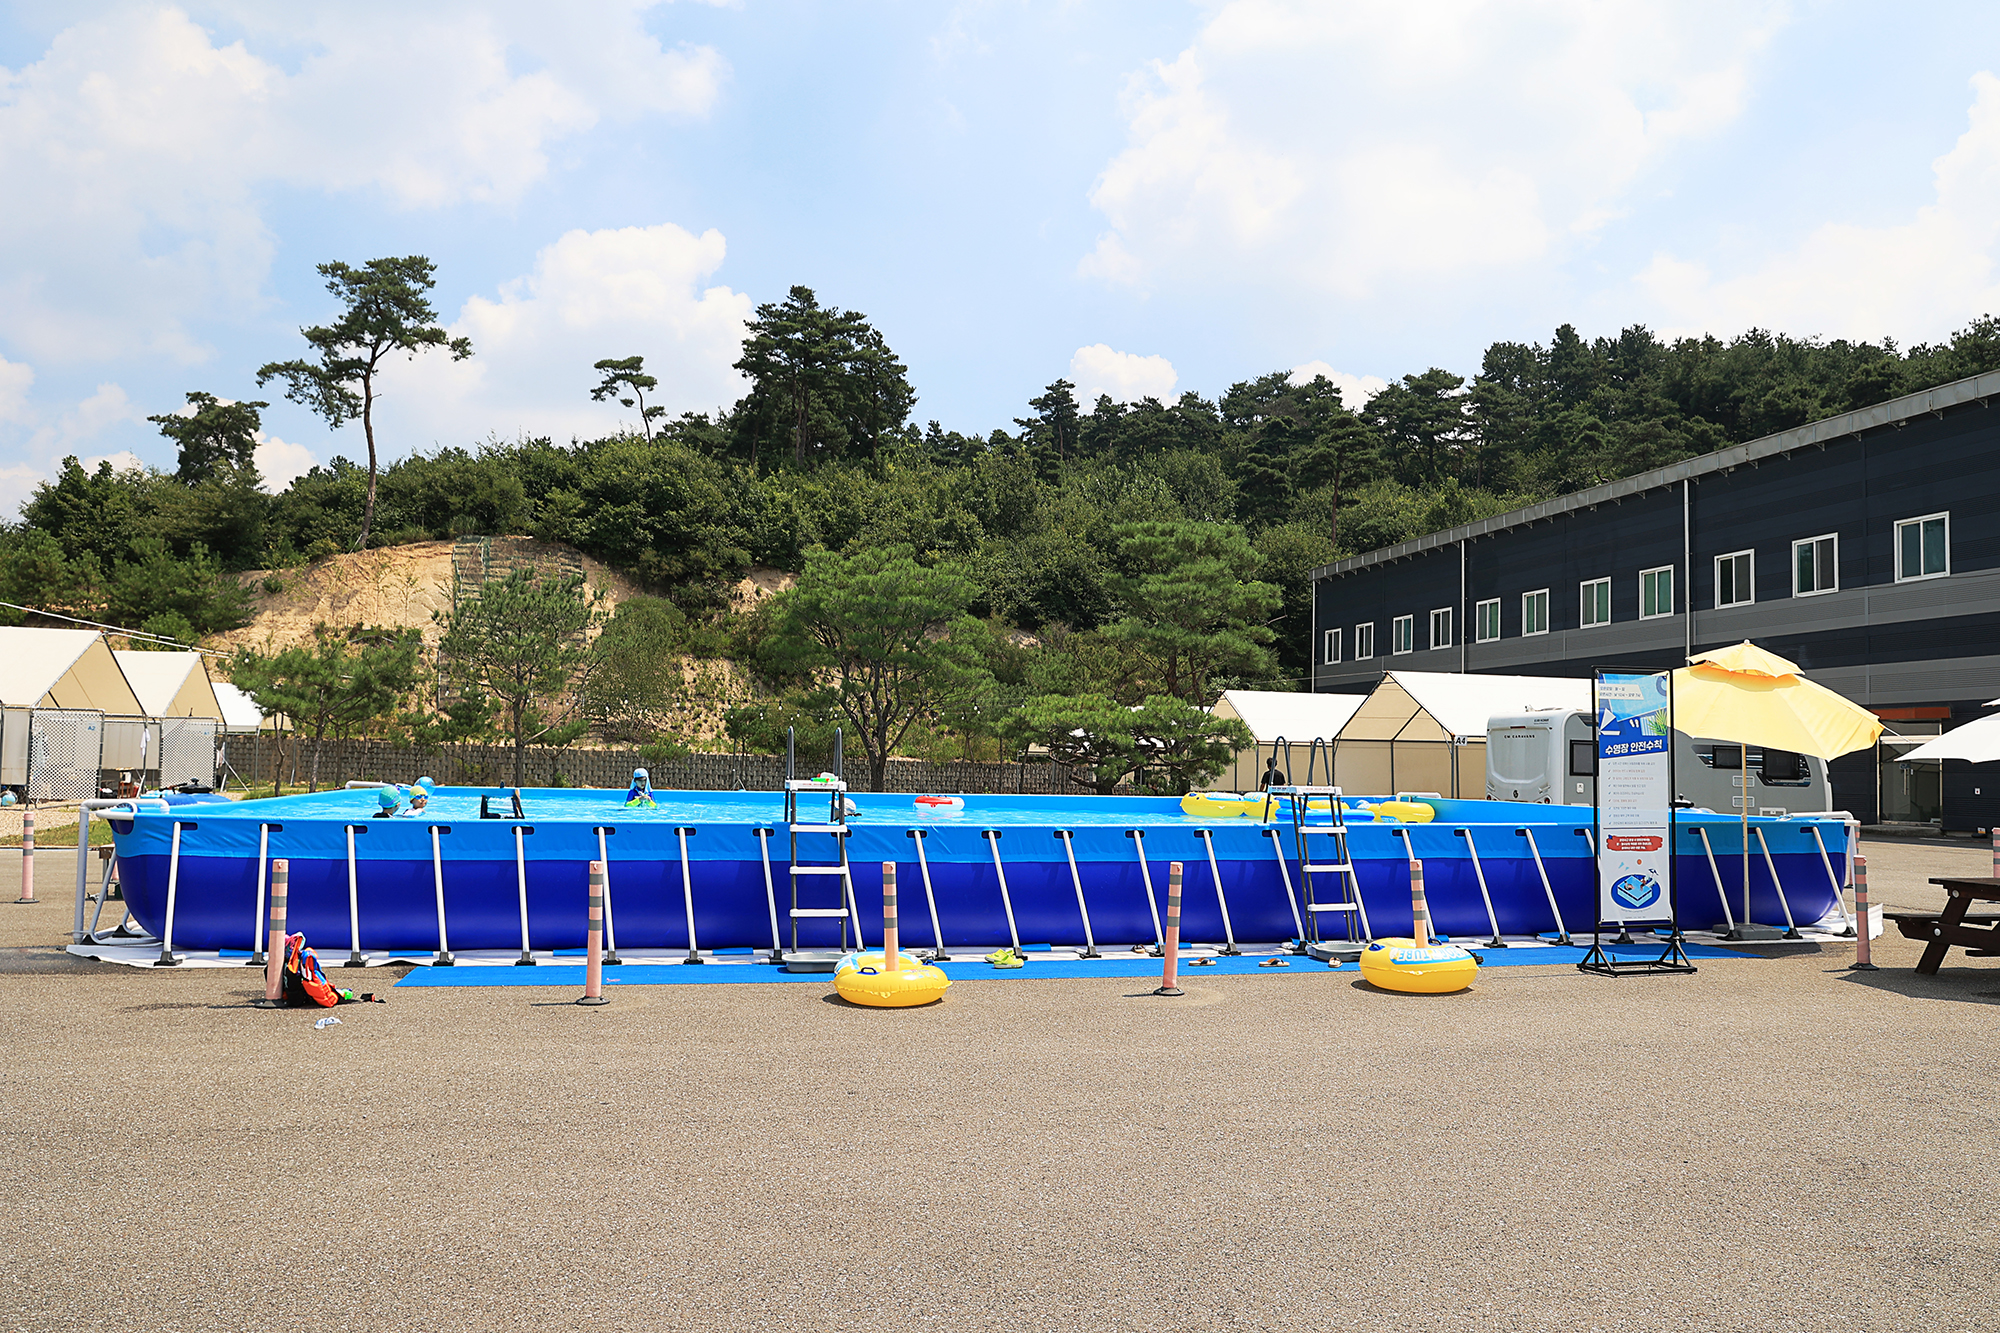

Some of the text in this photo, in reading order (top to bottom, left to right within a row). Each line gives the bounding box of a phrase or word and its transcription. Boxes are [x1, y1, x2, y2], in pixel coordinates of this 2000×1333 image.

[1455, 736, 1466, 745] A4
[1605, 739, 1663, 755] 수영장 안전수칙
[1397, 948, 1432, 961] TUBE
